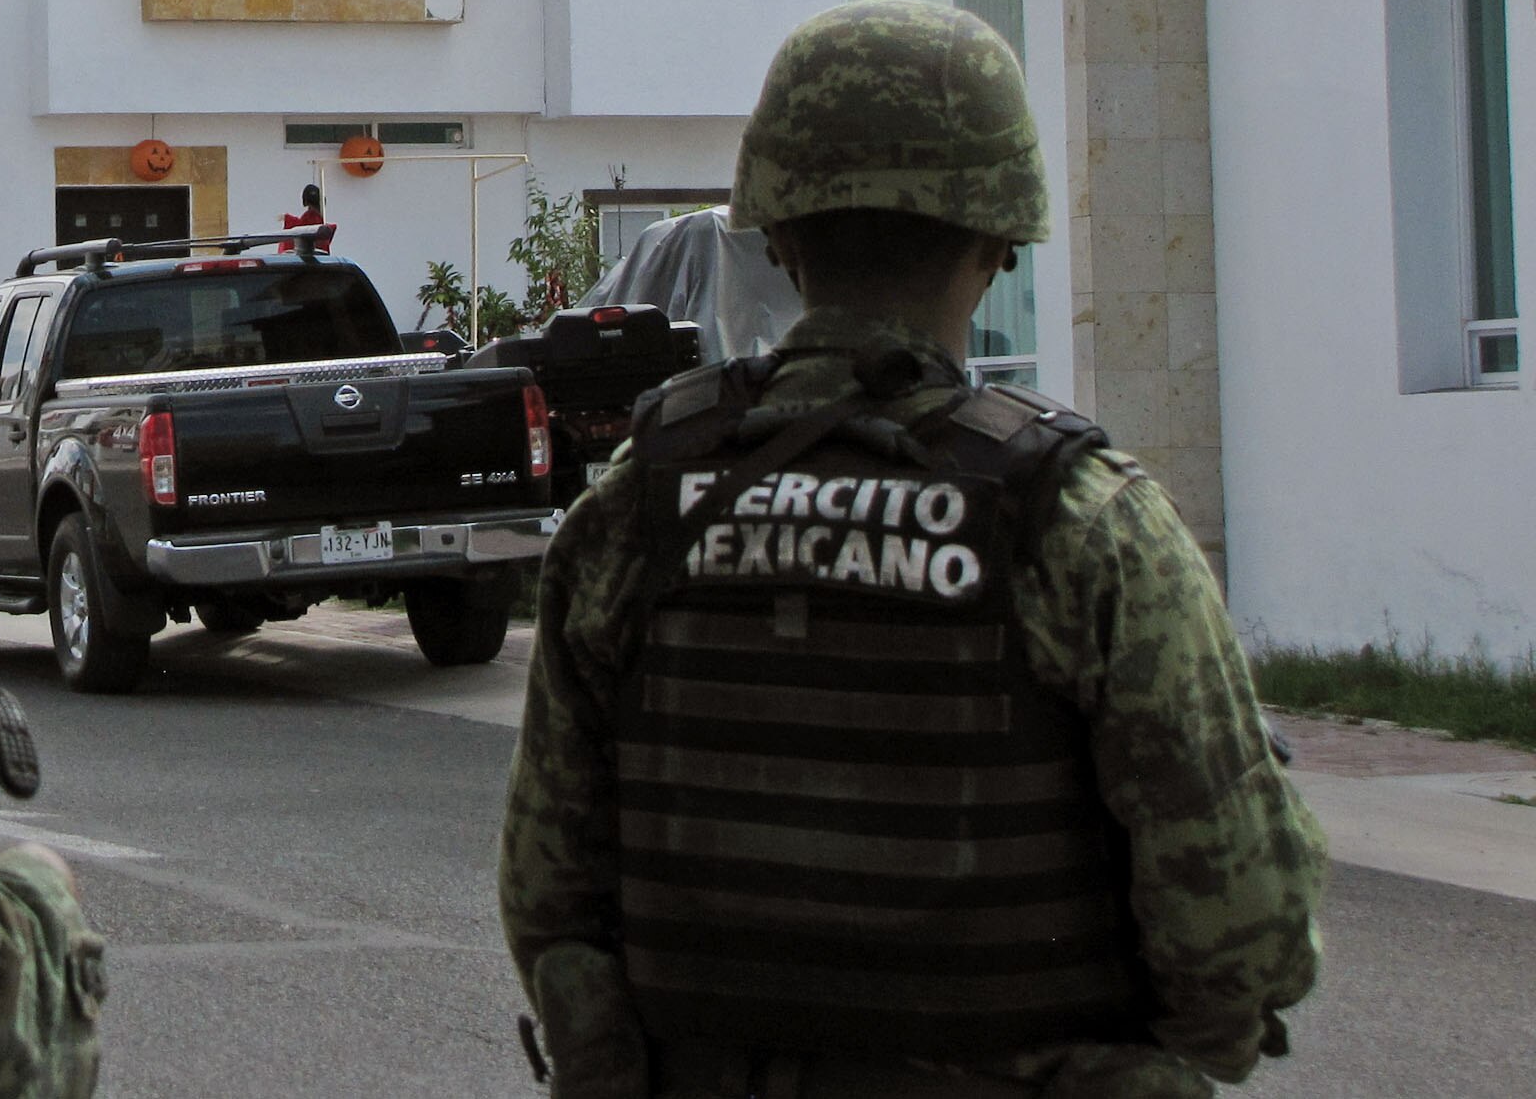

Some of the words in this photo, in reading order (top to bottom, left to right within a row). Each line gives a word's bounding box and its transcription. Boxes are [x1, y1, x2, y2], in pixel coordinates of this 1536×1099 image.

[460, 473, 483, 486] SE
[187, 490, 267, 507] FRONTIER
[678, 472, 966, 535] EERCITO
[327, 532, 389, 552] 132-YJN
